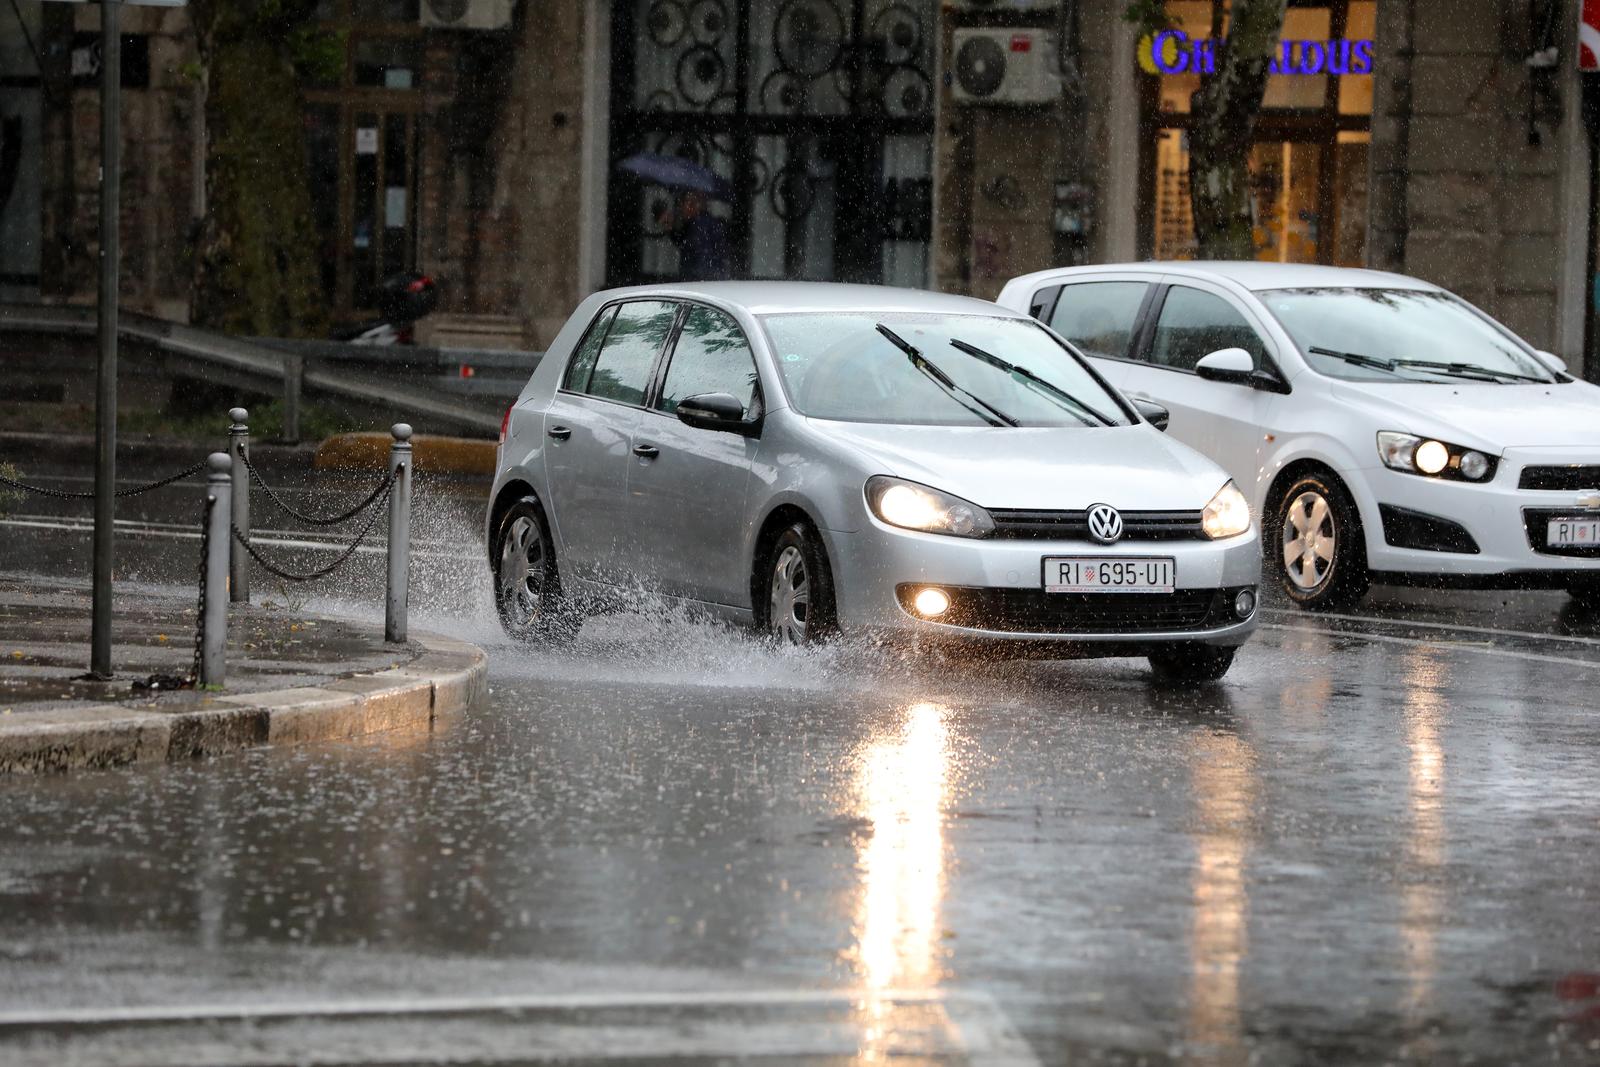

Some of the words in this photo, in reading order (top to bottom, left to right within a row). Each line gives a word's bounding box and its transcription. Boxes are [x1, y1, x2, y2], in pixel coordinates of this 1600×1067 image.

[1152, 30, 1373, 75] GHLDUS
[1088, 504, 1122, 540] VW
[1559, 523, 1575, 542] RI
[1059, 562, 1080, 585] RI
[1099, 562, 1168, 585] 695-UI
